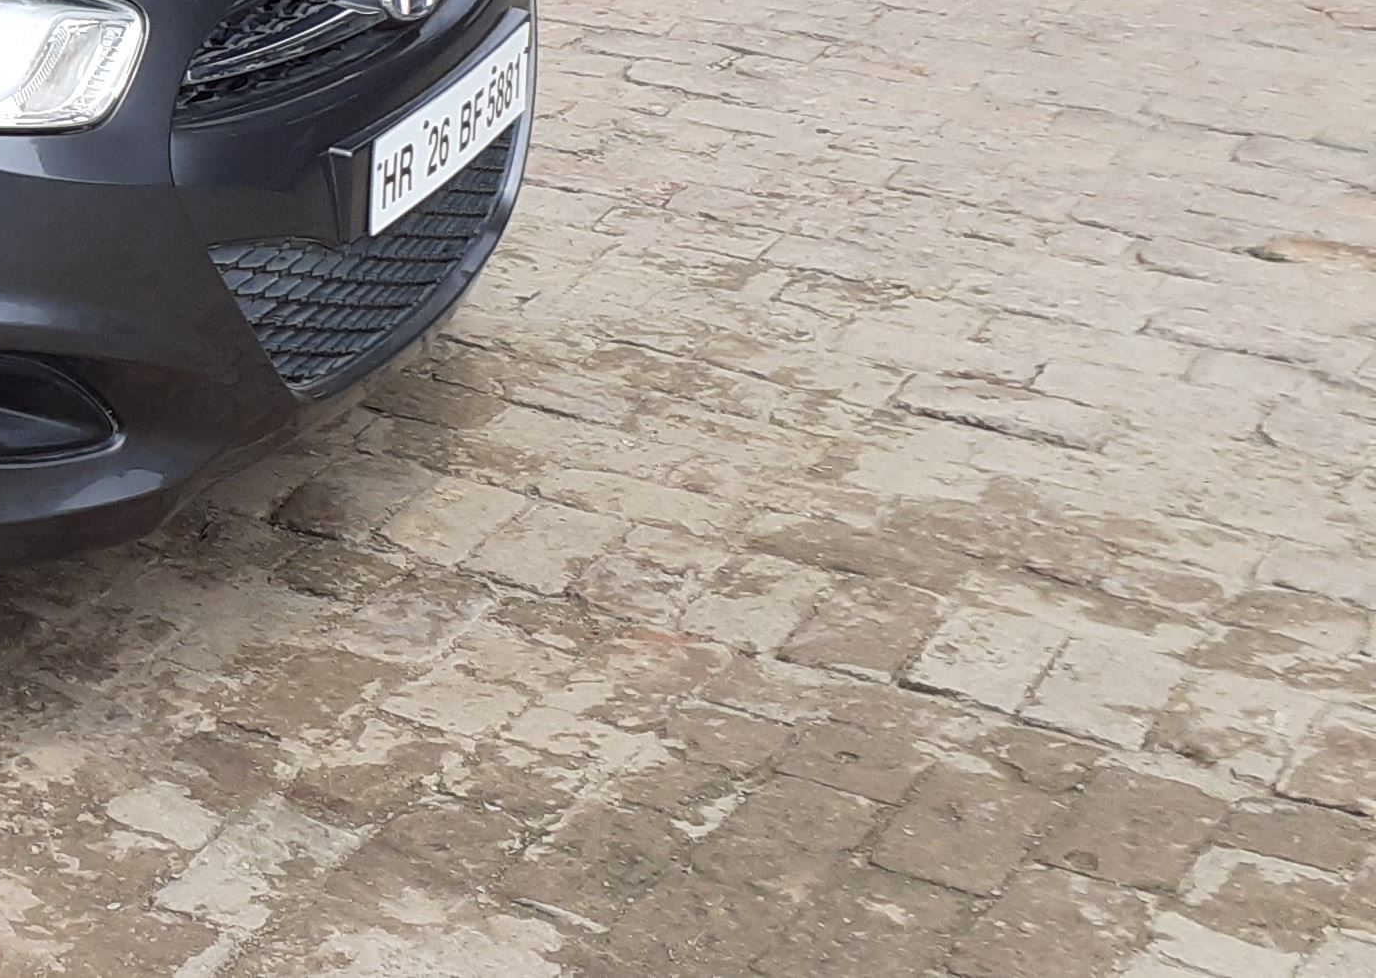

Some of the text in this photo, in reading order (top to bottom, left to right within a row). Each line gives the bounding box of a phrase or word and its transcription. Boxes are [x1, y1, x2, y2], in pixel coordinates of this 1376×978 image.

[381, 53, 521, 210] HR 26 BF 5881
